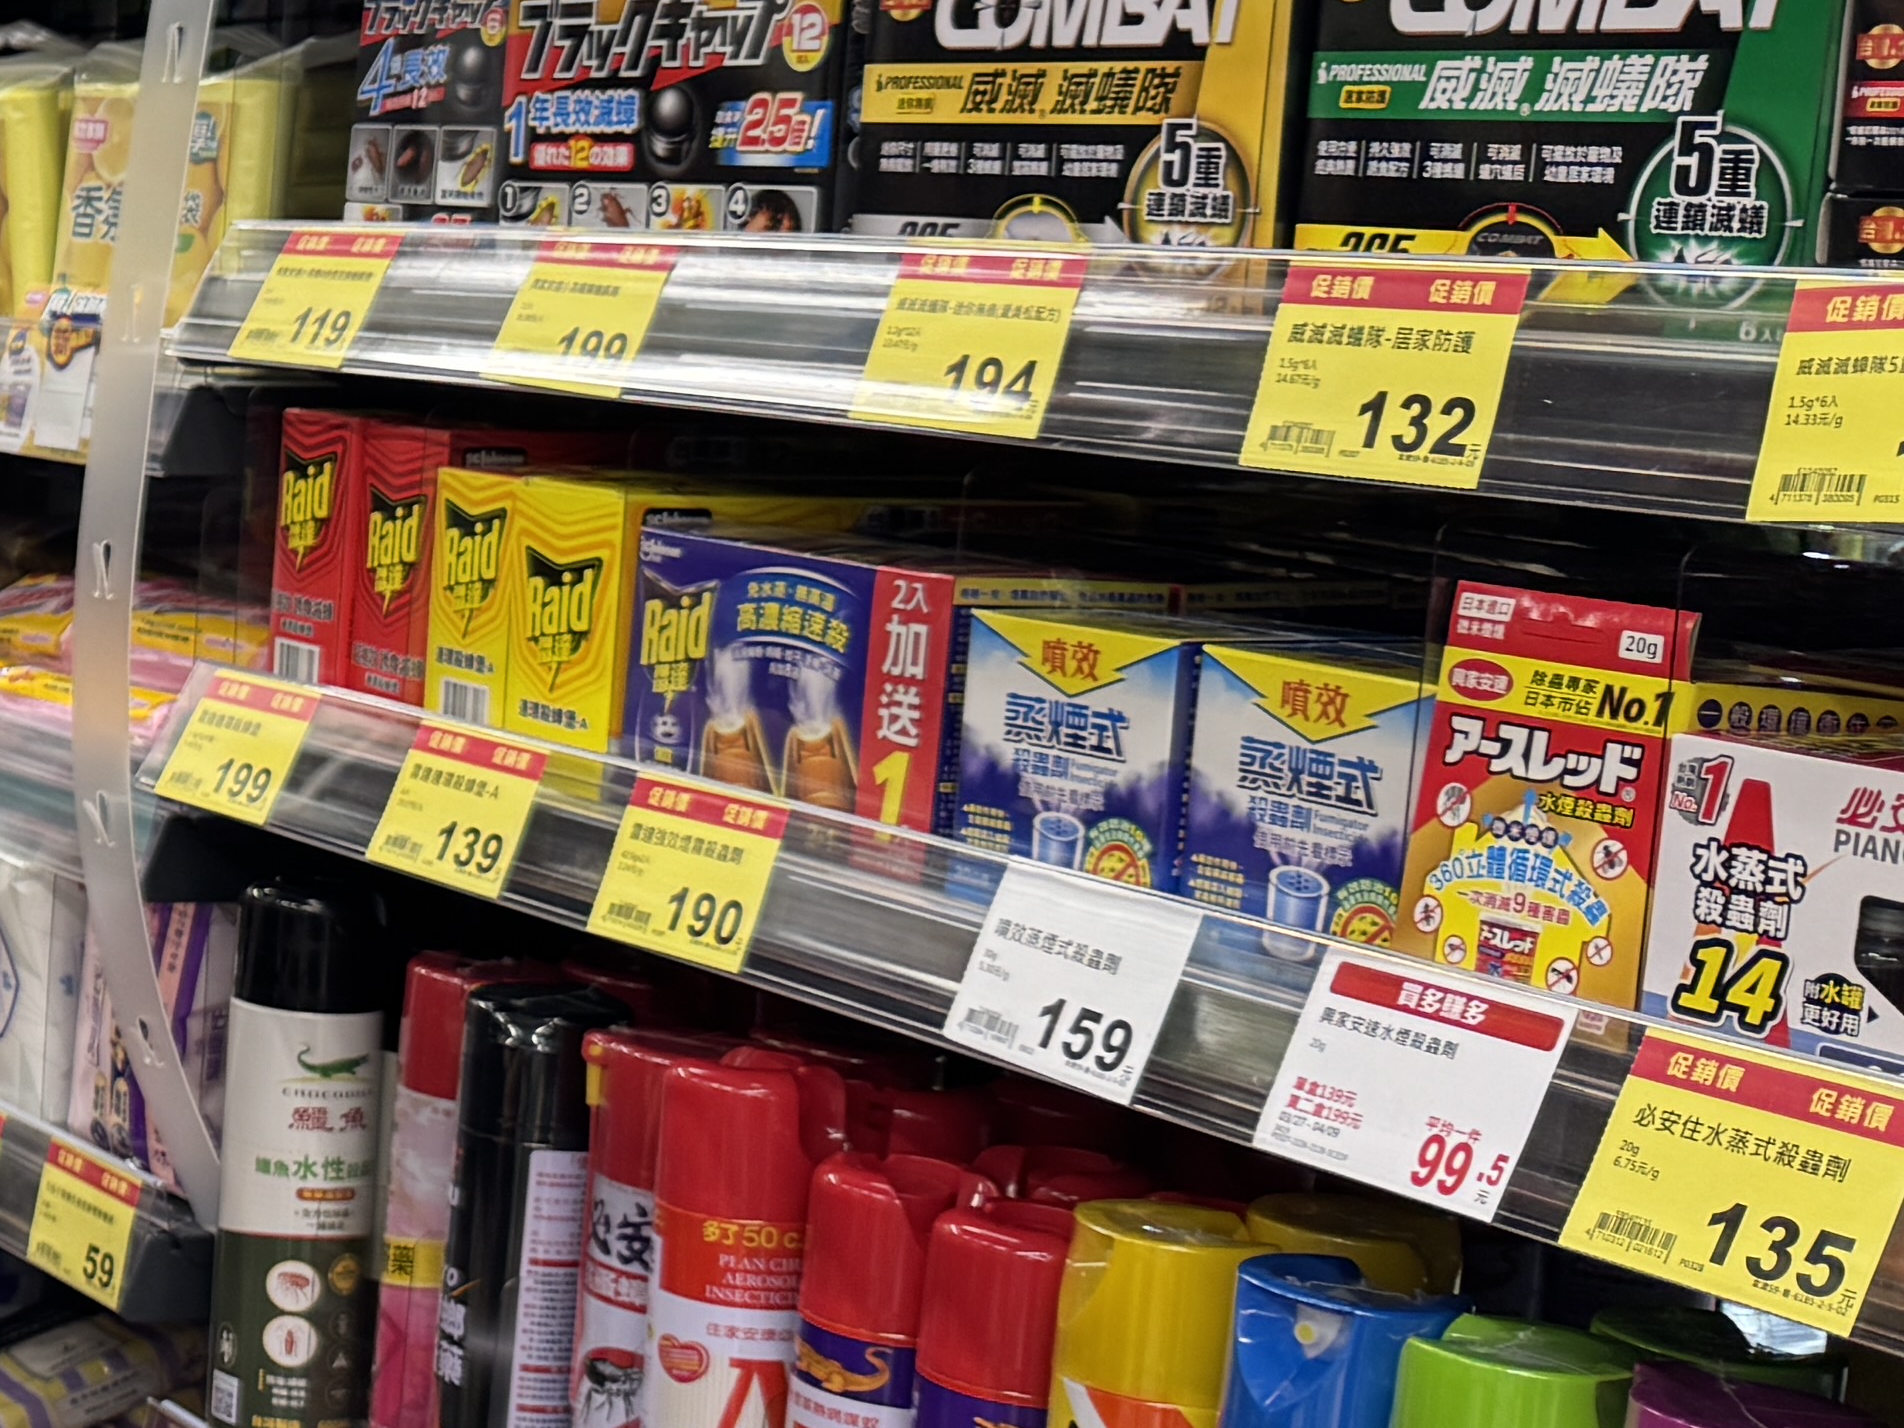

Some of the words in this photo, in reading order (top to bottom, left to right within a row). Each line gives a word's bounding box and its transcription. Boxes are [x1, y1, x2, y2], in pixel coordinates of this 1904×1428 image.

[791, 11, 825, 52] 12
[1328, 63, 1427, 83] PROFESSIONAL
[1418, 55, 1533, 111] 威滅
[1534, 52, 1711, 114] 滅蟻隊
[1670, 115, 1760, 203] 5重
[1649, 198, 1770, 239] 連鎖滅蟻
[1357, 390, 1476, 458] 132
[280, 454, 335, 530] Raid
[367, 503, 421, 572] Raid
[442, 514, 502, 589] Raid
[525, 564, 596, 640] Raid
[891, 578, 930, 614] 2入
[640, 589, 713, 668] Raid
[1624, 634, 1659, 660] 20g
[876, 614, 930, 748] 加送
[1279, 679, 1351, 729] 噴效
[1595, 683, 1675, 729] No.1
[1003, 692, 1130, 764] 蒸煙式
[1443, 715, 1644, 795] アースレッド
[213, 757, 273, 804] 199
[1237, 735, 1383, 817] 蒸煙式
[436, 821, 504, 874] 139
[1693, 840, 1807, 900] 水蒸式
[1833, 828, 1904, 865] PIAN
[667, 886, 744, 946] 190
[1694, 887, 1791, 940] 殺蟲劑
[1396, 980, 1490, 1026] 買多賺多
[1673, 942, 1792, 1032] 14
[1802, 1000, 1861, 1035] 更好用
[1038, 998, 1133, 1072] 159
[1668, 1051, 1746, 1094] 促銷價
[1809, 1086, 1895, 1133] 促銷價
[1633, 1102, 1852, 1184] 必安住水蒸式殺蟲劑
[82, 1243, 115, 1289] 59
[1707, 1202, 1857, 1298] 135
